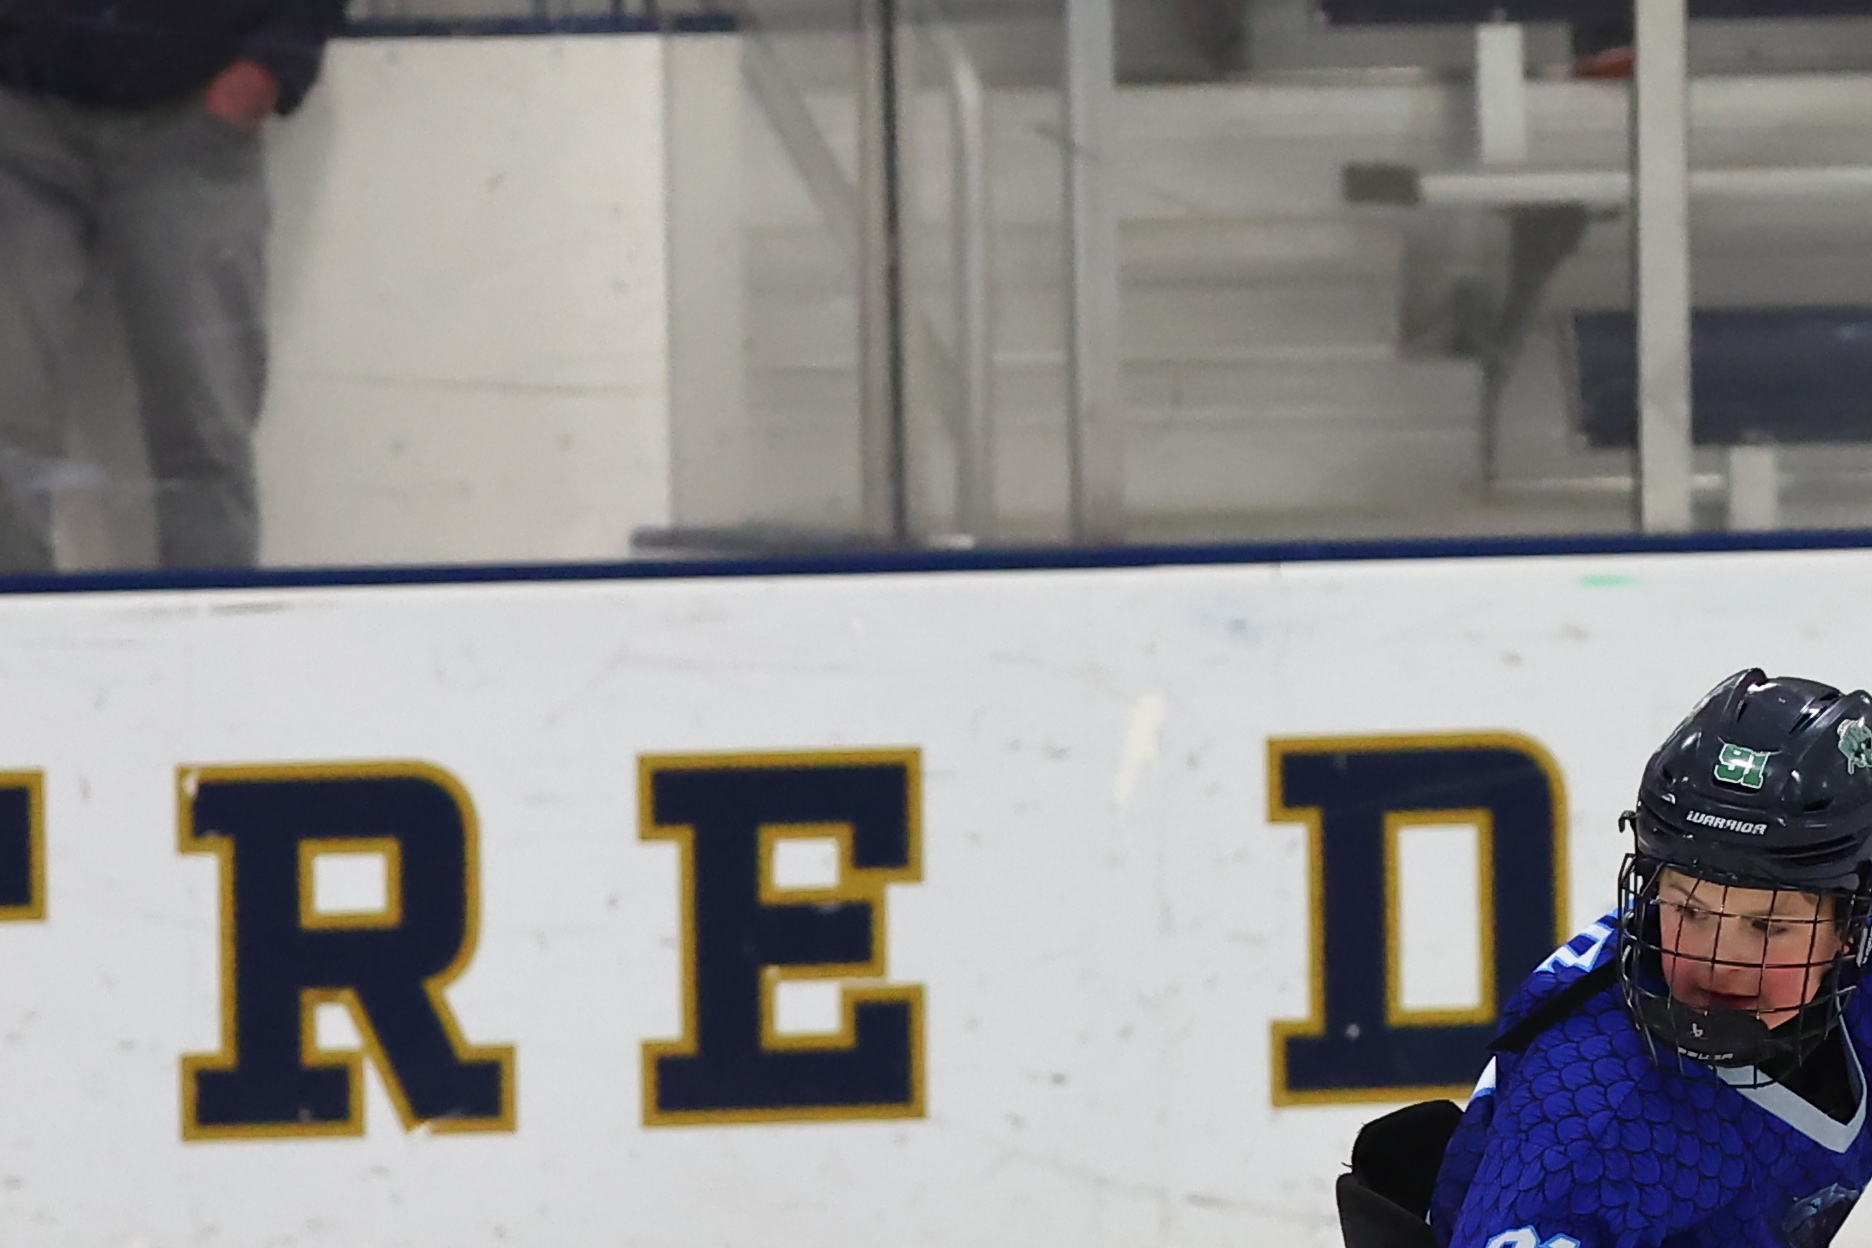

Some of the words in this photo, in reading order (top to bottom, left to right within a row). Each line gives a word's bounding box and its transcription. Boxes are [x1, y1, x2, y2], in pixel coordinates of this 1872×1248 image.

[1714, 743, 1770, 789] 91
[1686, 810, 1768, 836] WARRIOR
[0, 747, 928, 1142] RE
